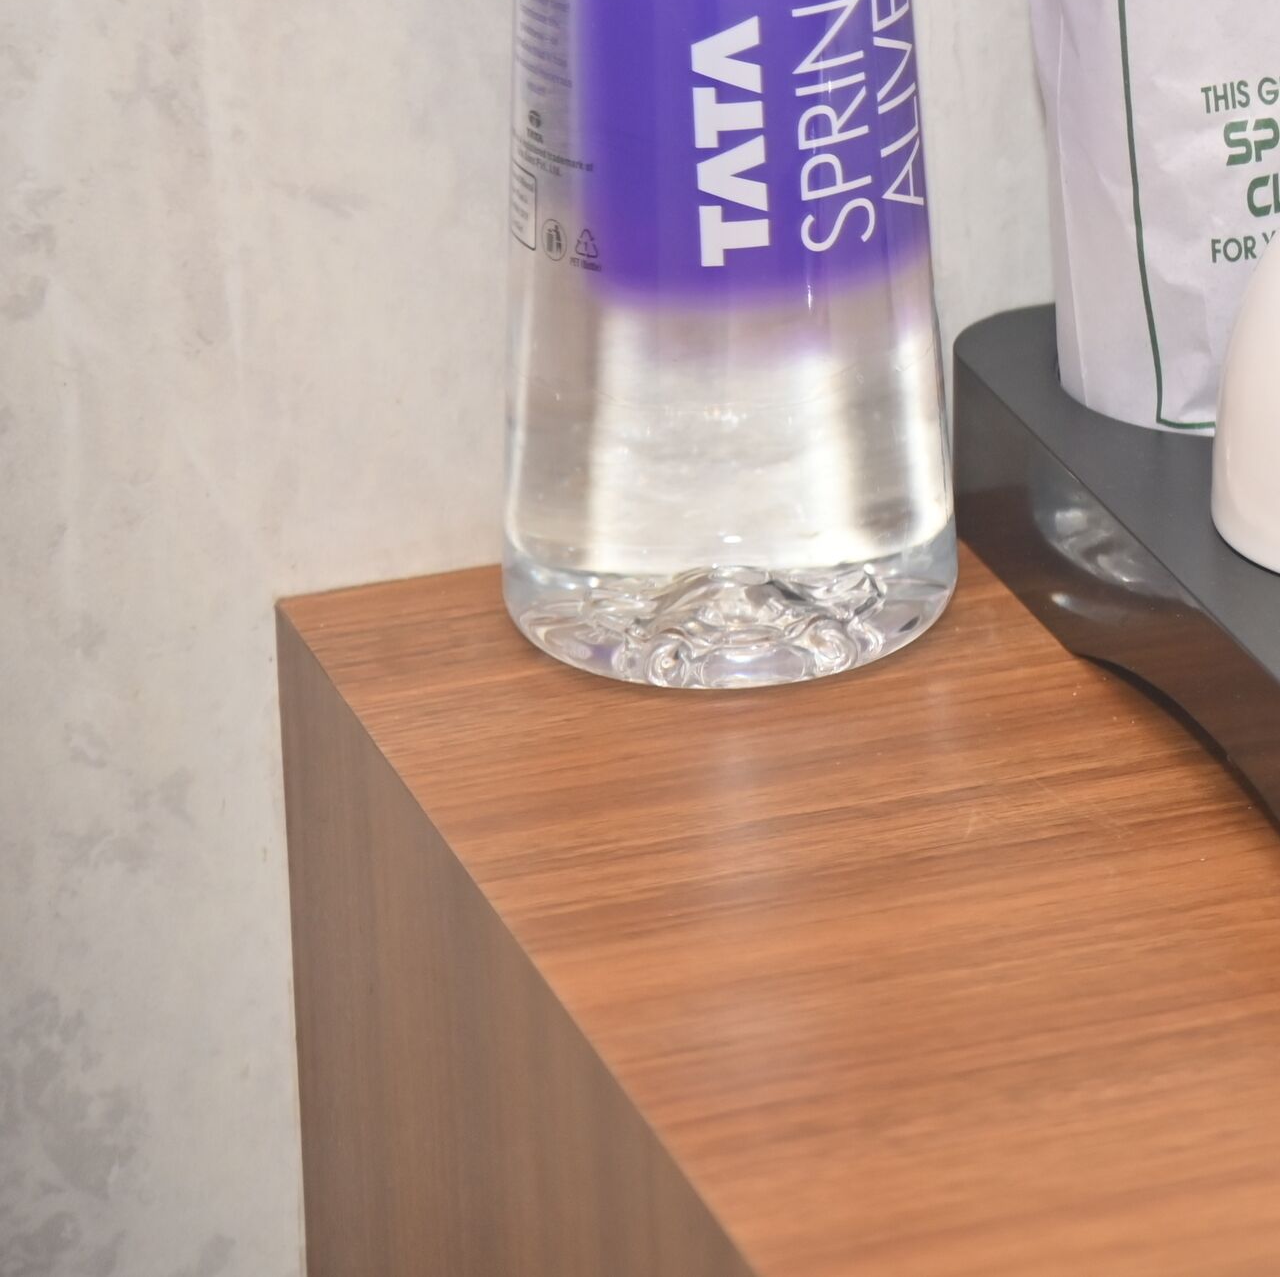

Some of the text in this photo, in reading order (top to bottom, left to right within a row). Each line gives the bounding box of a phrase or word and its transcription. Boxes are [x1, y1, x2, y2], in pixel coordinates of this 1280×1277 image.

[1201, 80, 1250, 114] THIS
[691, 16, 770, 267] TATA
[1211, 235, 1257, 263] FOR
